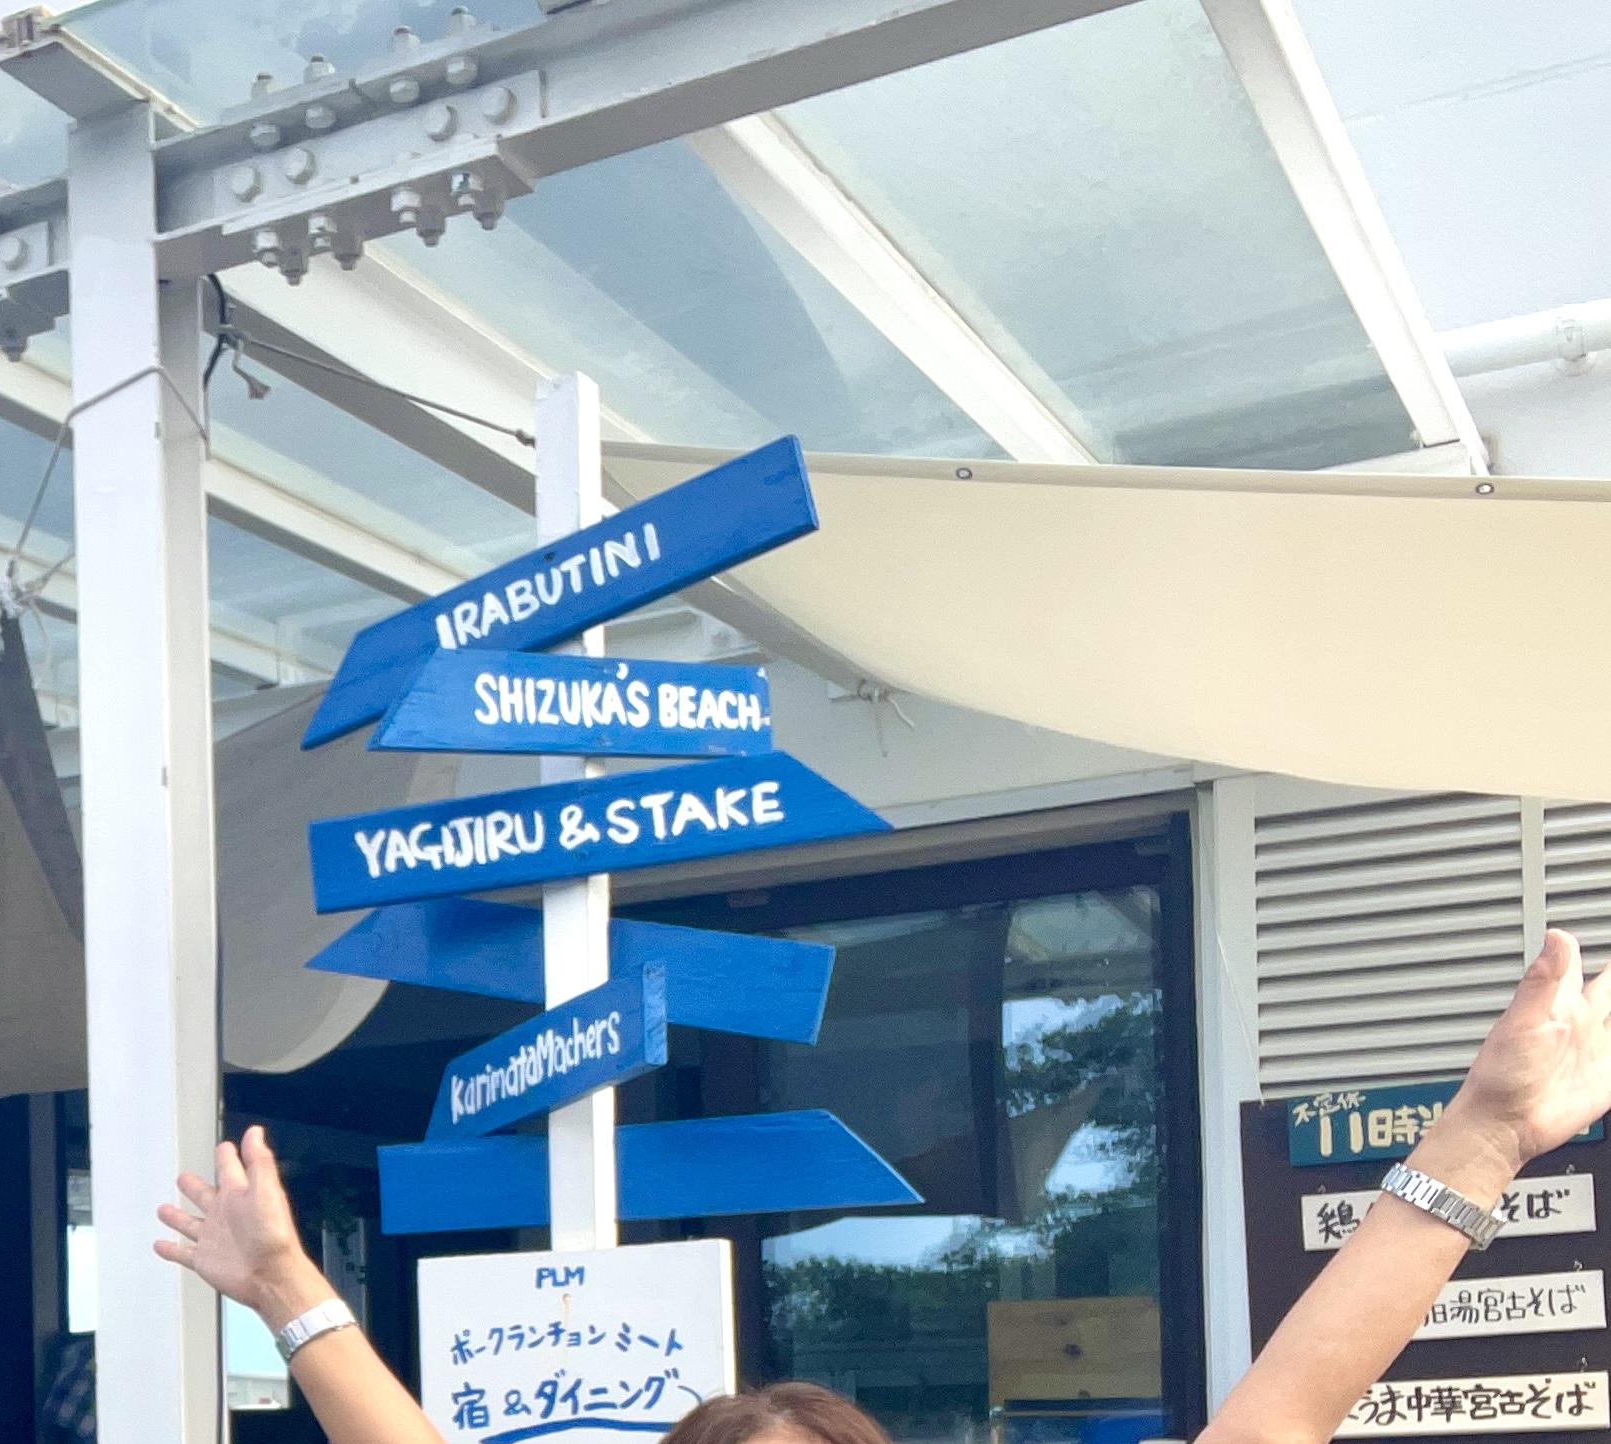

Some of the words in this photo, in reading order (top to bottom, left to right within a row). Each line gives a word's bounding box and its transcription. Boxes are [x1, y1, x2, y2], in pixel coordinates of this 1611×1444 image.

[434, 522, 662, 650] IRABUTINI
[474, 662, 650, 729] SHIZUKA'S
[657, 682, 762, 732] BEACH
[354, 809, 546, 879] YAGIJIRU
[559, 804, 600, 851] &
[606, 780, 786, 845] STAKE
[535, 1265, 586, 1290] PLM
